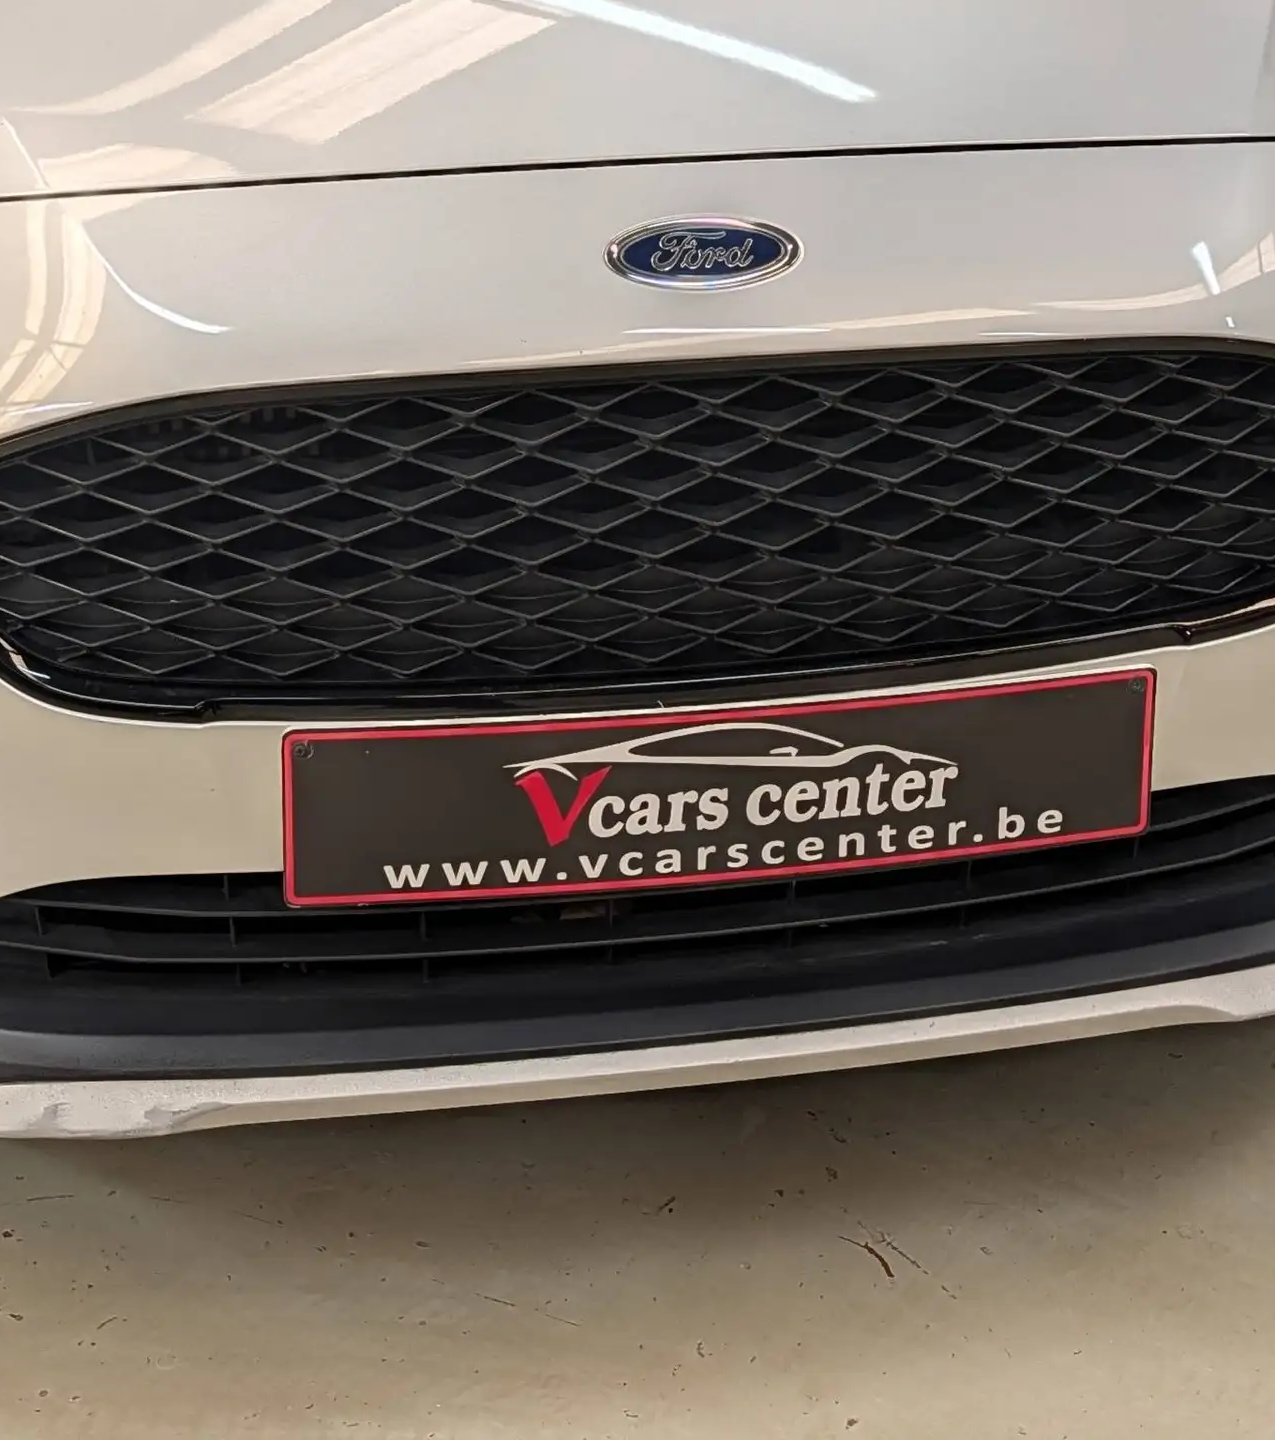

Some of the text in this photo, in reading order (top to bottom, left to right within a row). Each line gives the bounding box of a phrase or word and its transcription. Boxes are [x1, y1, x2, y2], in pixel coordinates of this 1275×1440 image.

[651, 231, 755, 271] Ford
[515, 763, 959, 847] Vcars center
[383, 806, 1064, 889] www.vcarscenter.be
